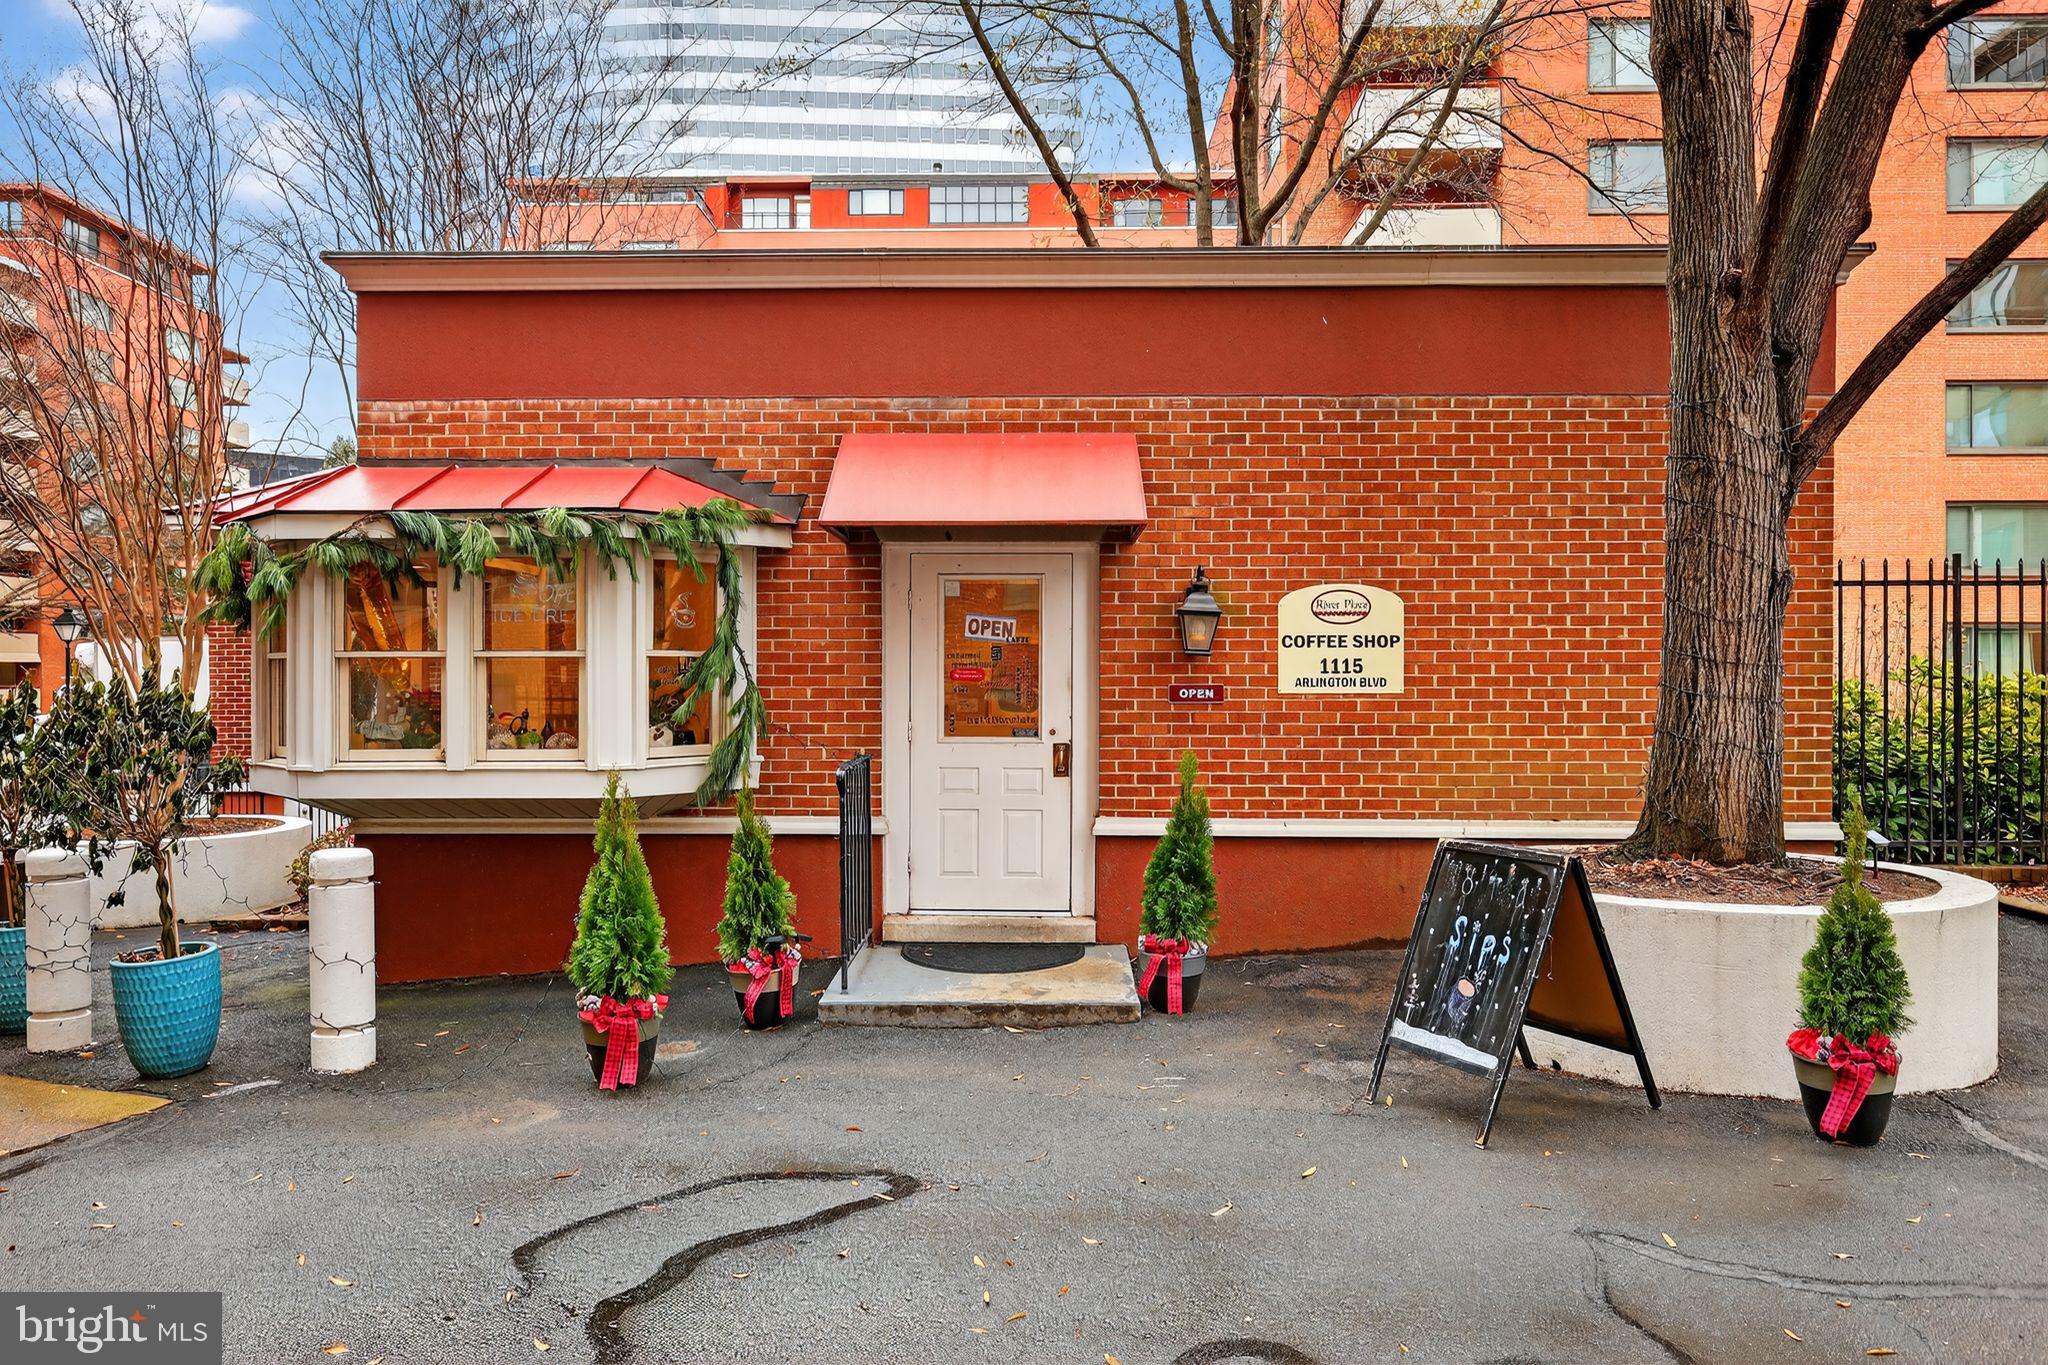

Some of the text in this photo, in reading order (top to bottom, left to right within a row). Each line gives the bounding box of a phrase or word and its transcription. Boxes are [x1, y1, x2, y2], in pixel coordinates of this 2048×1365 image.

[1316, 598, 1368, 610] River Place
[532, 606, 577, 624] CRE
[967, 618, 1015, 638] OPEN
[1281, 634, 1401, 649] COFFEE SHOP
[1320, 657, 1364, 674] 1115
[1294, 676, 1388, 688] ARLINGTON BLVD
[1178, 688, 1214, 699] OPEN
